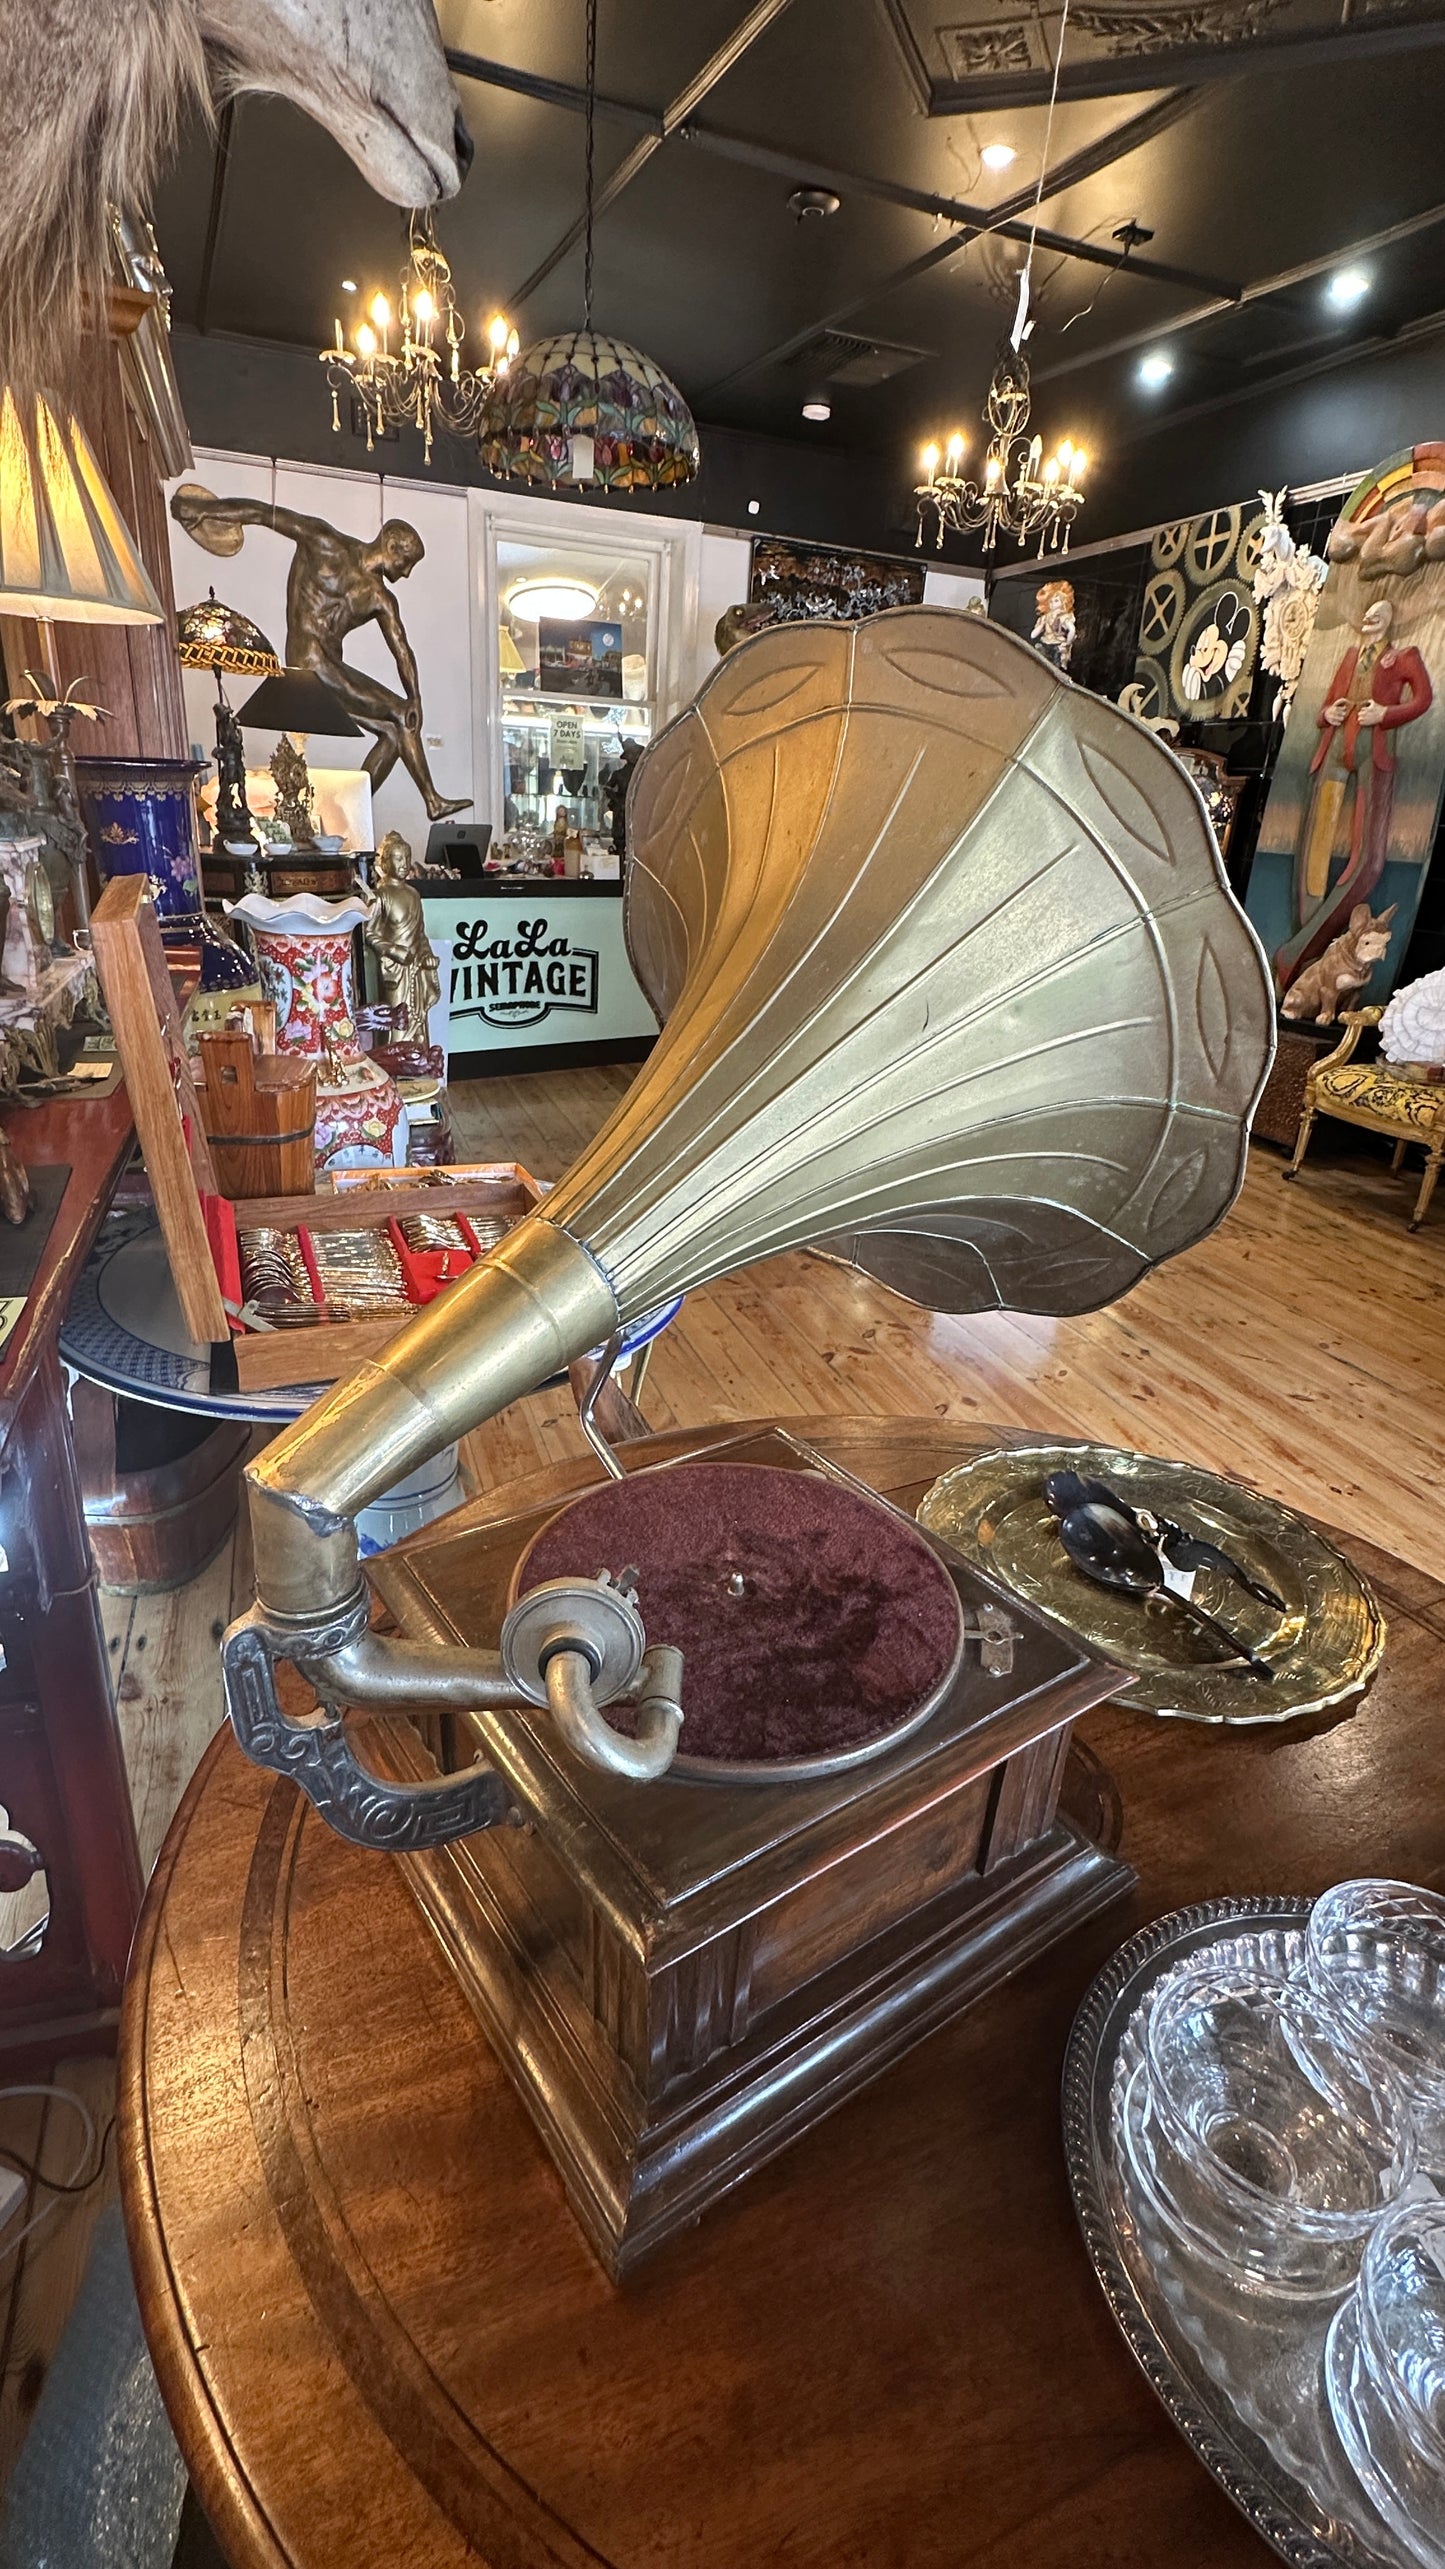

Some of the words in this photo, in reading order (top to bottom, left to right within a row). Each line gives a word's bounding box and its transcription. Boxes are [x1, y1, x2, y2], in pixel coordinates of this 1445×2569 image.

[556, 720, 578, 729] OPEN
[553, 729, 559, 737] 7
[560, 730, 581, 739] DAYS
